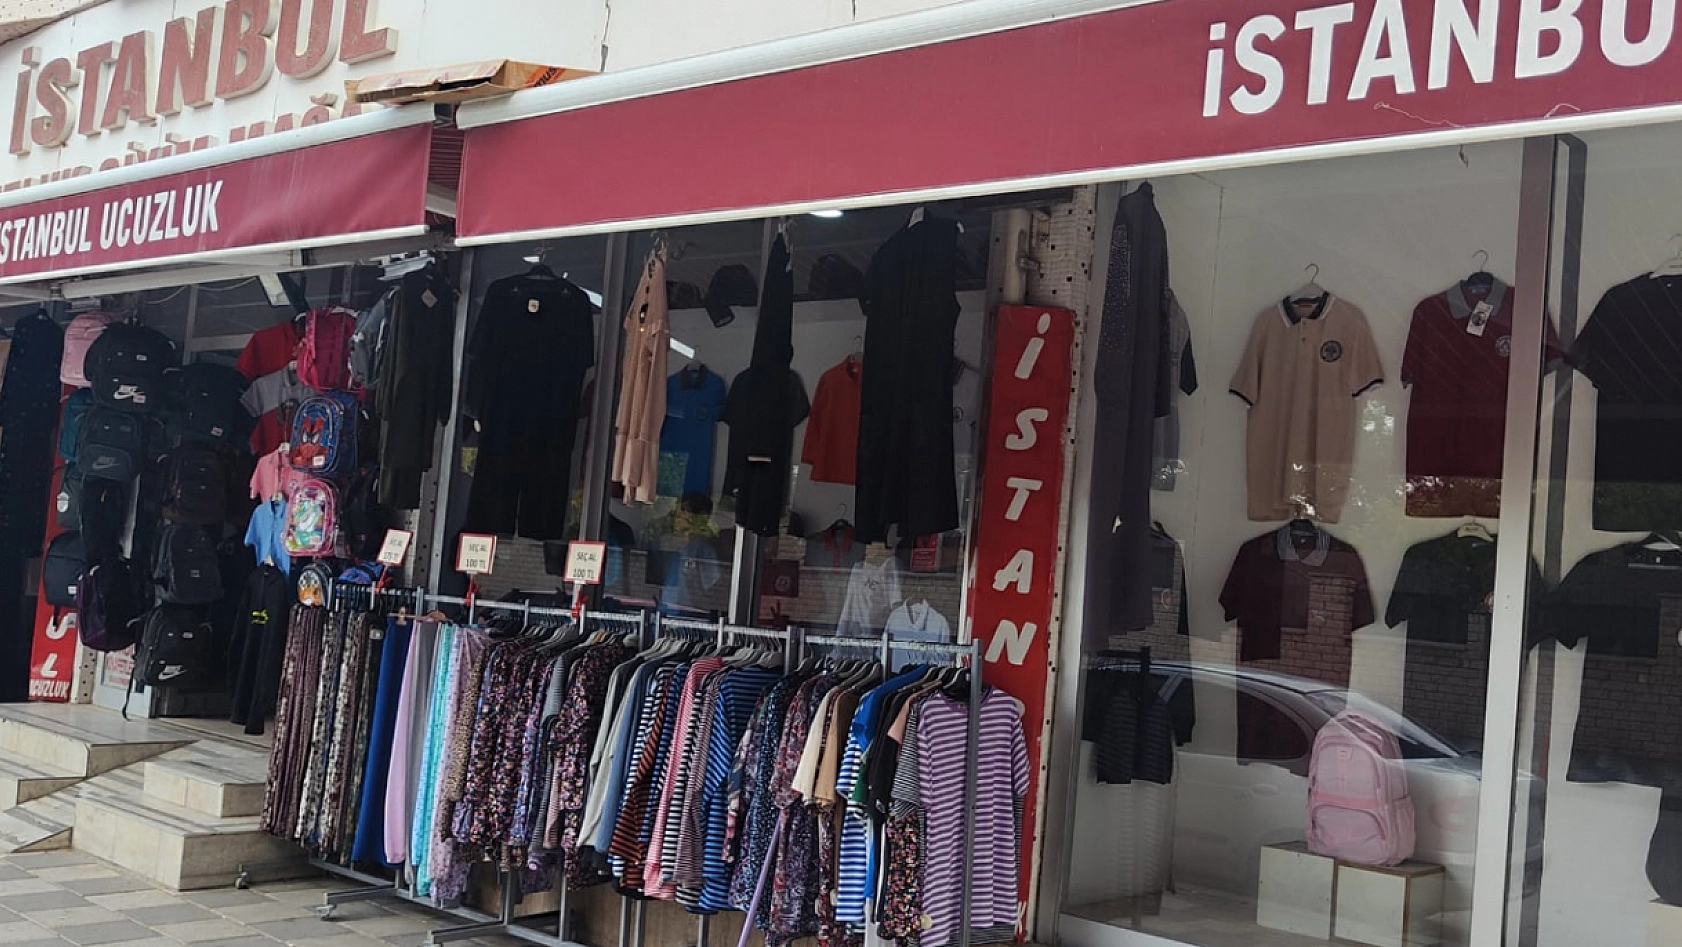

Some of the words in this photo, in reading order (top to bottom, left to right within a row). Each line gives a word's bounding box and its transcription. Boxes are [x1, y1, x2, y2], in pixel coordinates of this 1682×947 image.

[9, 0, 396, 157] İSTANBUL
[0, 206, 92, 264] STANBUL
[100, 180, 223, 249] UCUZLUK
